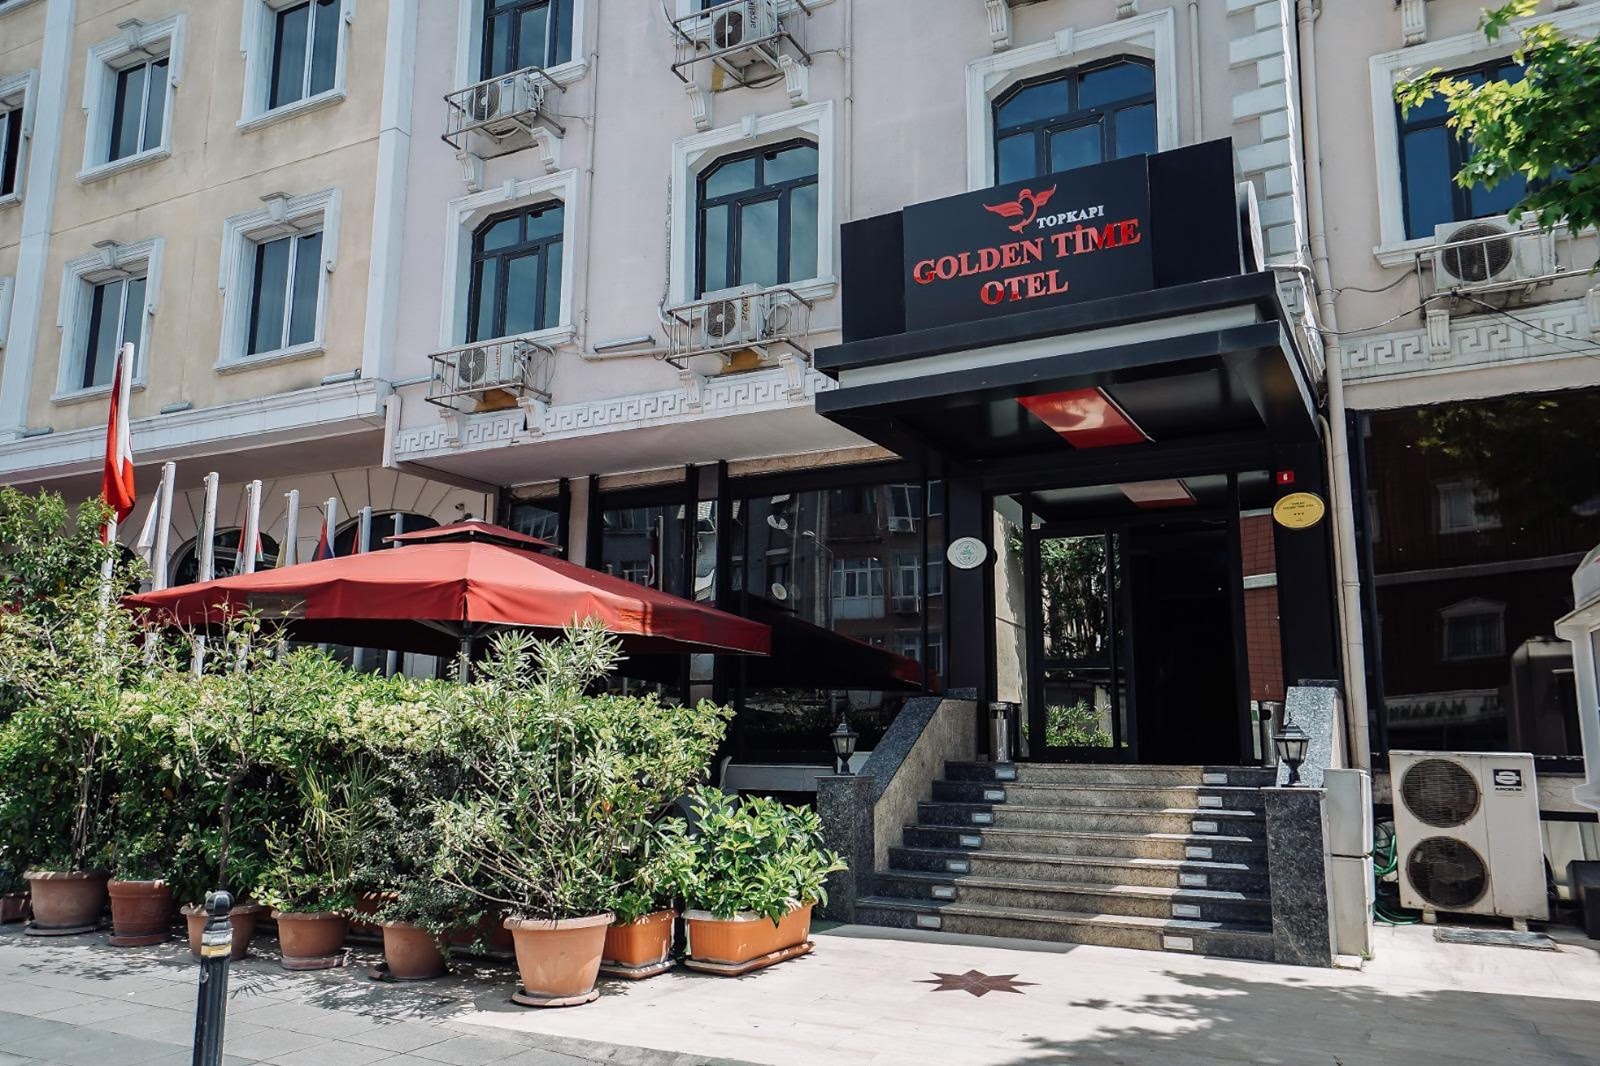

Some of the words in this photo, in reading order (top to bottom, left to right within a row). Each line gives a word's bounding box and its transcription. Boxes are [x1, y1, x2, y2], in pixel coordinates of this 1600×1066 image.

[1037, 205, 1104, 229] TOPKAPI
[913, 237, 1044, 285] GOLDEN
[1050, 218, 1141, 258] TİME
[980, 269, 1069, 305] OTEL
